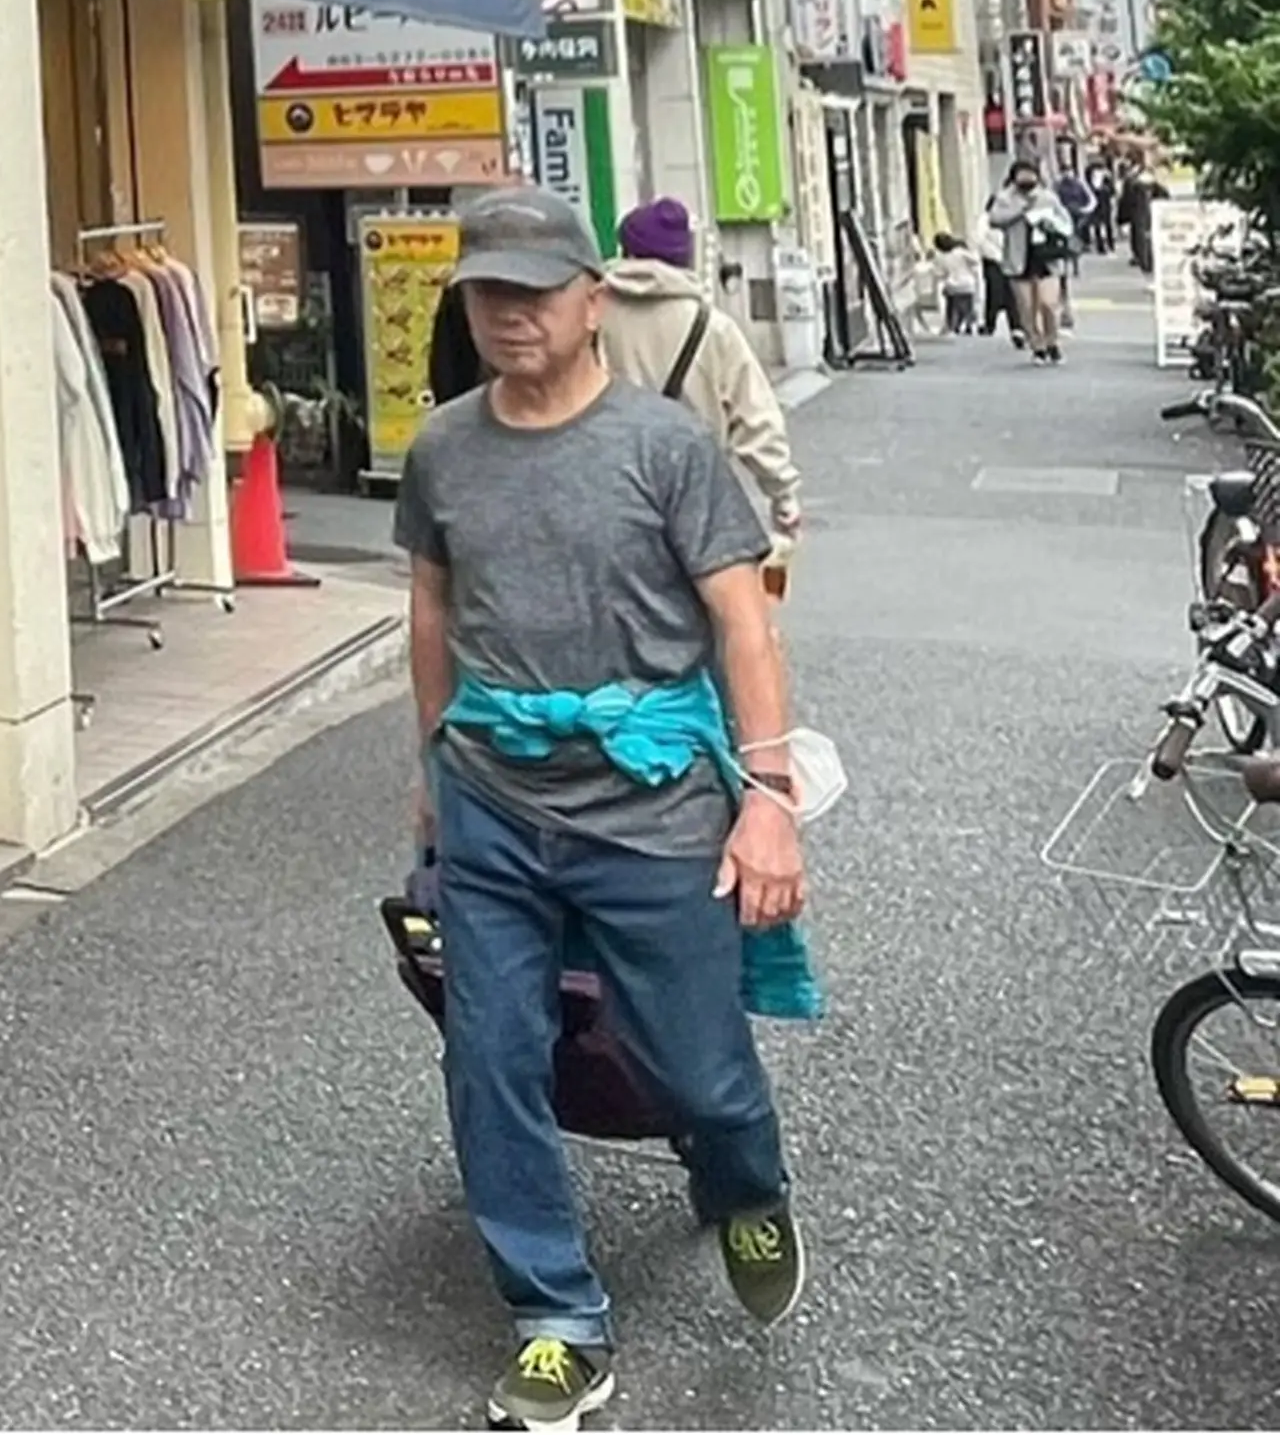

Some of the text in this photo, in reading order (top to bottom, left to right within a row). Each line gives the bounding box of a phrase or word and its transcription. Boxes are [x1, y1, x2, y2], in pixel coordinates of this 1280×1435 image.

[334, 101, 428, 126] ヒマラヤ
[543, 107, 581, 203] Fami
